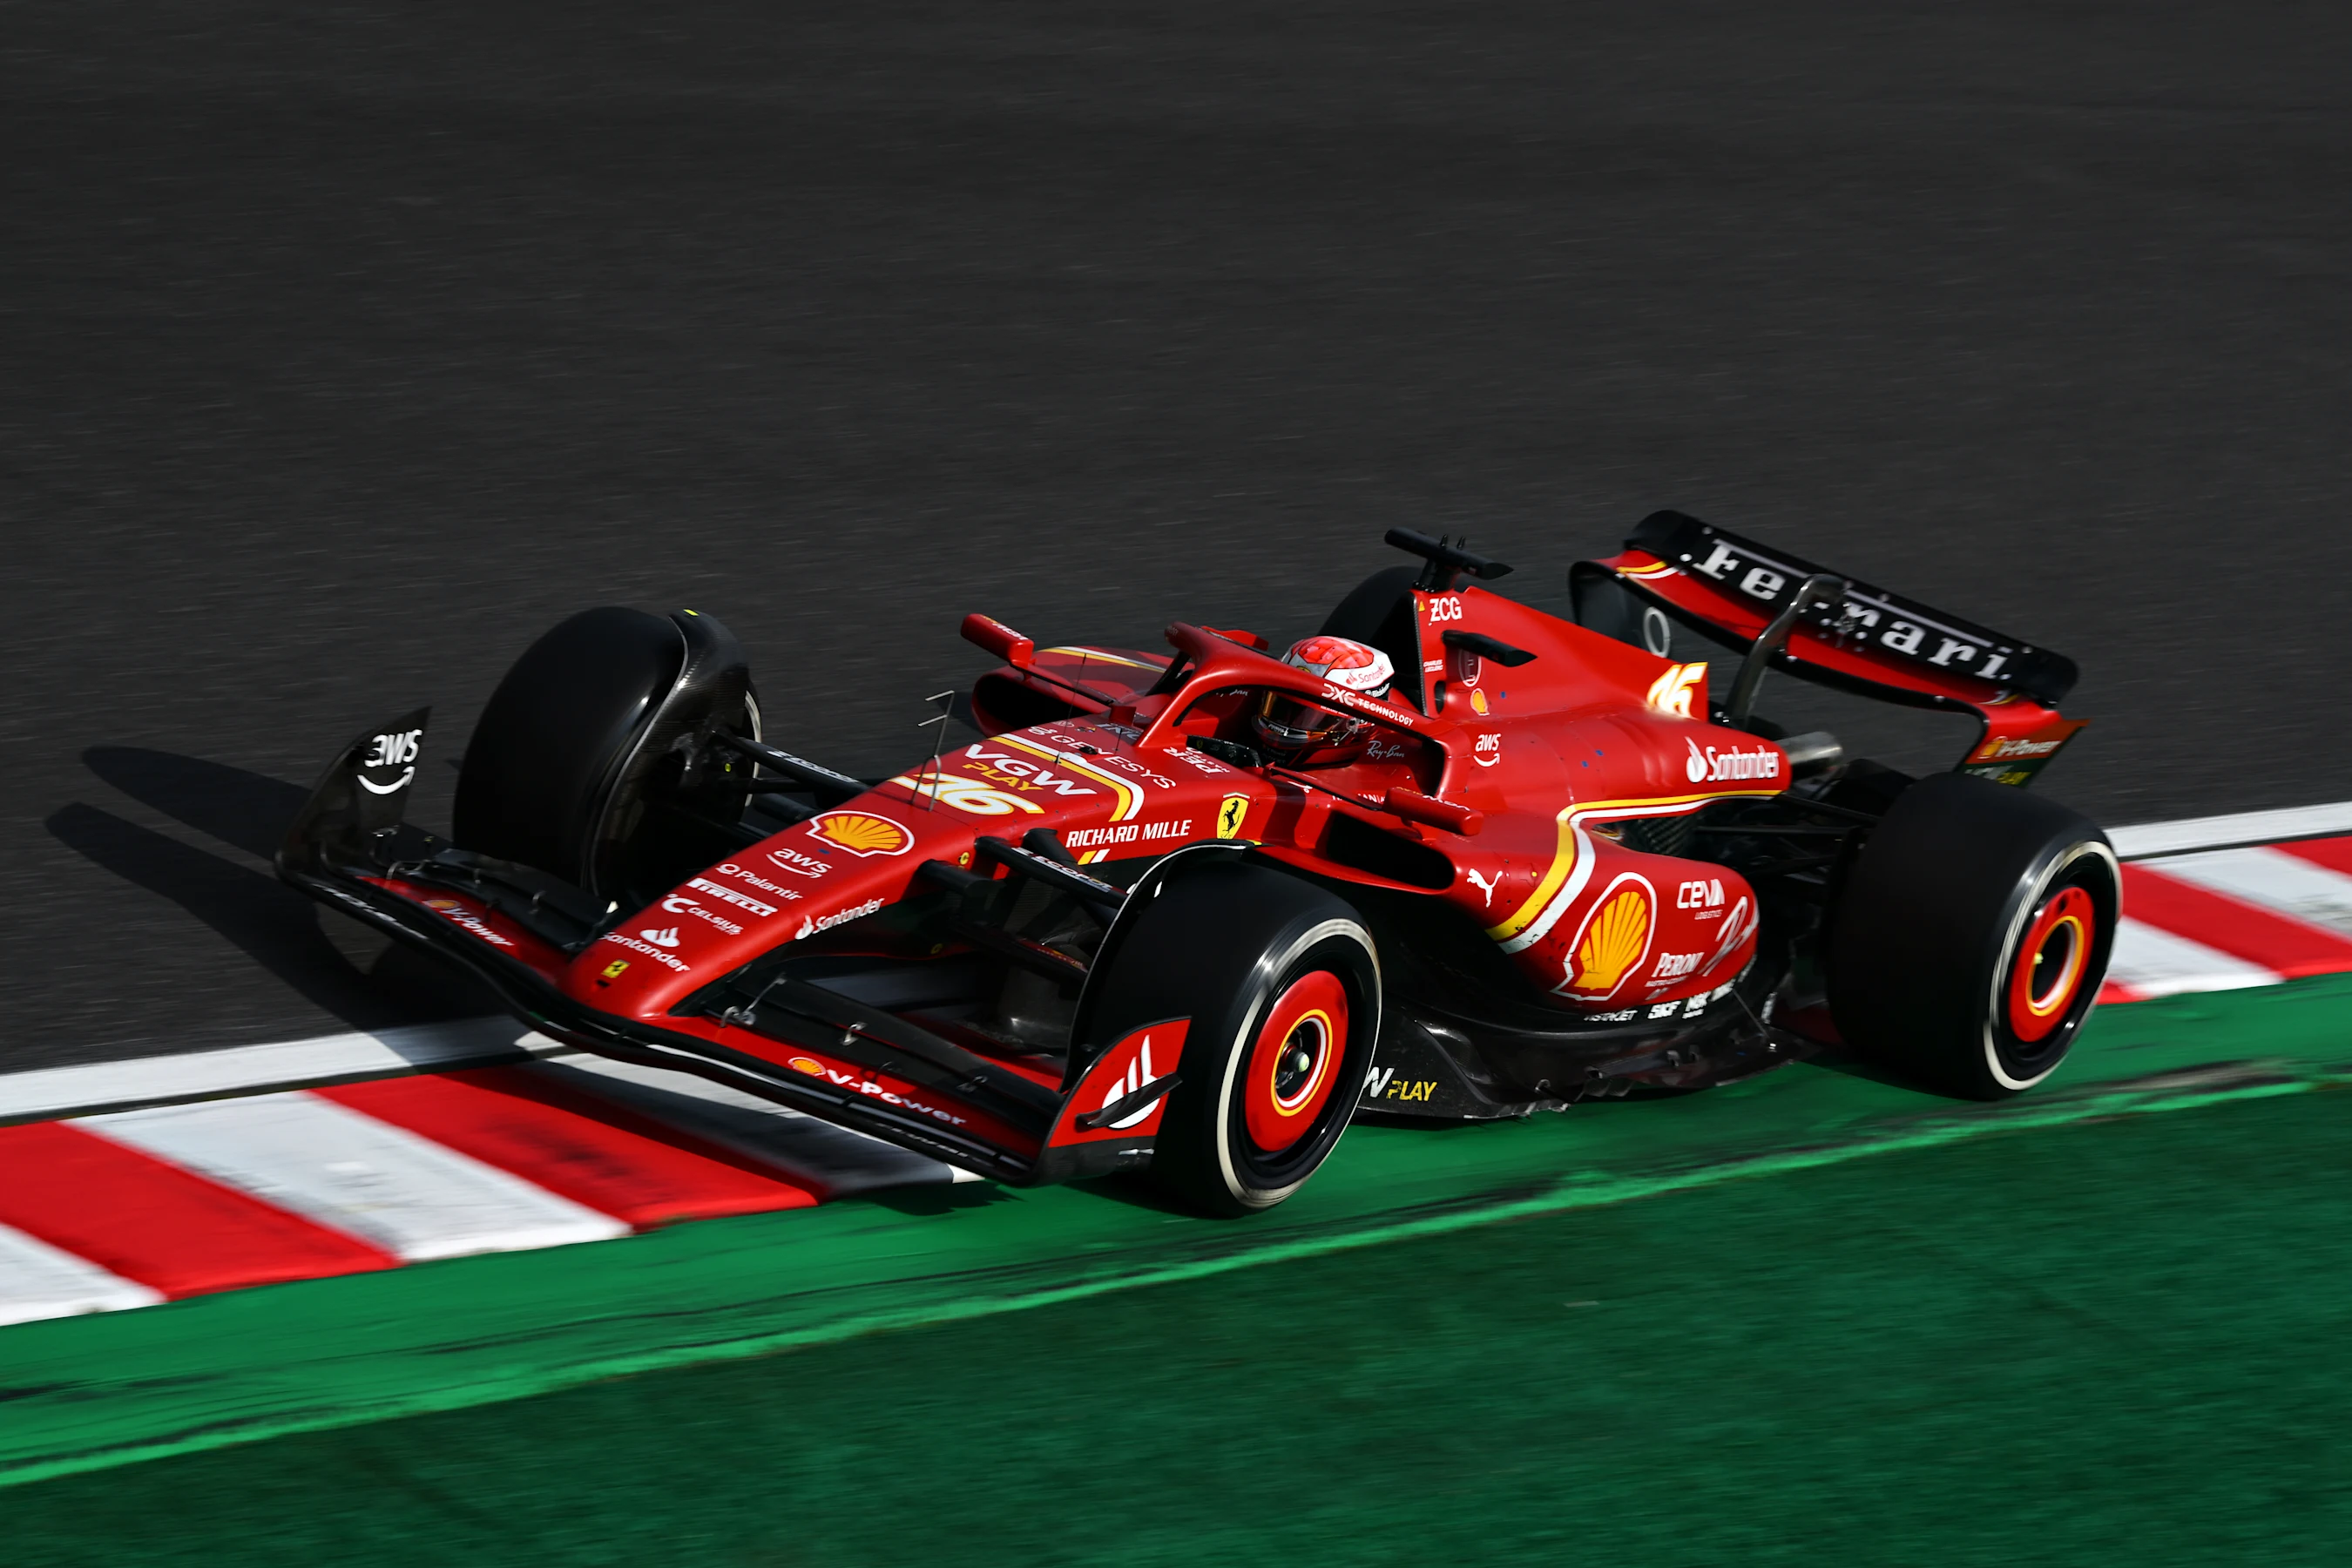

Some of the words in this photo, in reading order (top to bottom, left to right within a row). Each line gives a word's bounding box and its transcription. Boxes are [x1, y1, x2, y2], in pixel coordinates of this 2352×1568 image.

[1429, 597, 1463, 622] ZCG
[1692, 538, 2013, 679] Ferari
[1646, 662, 1708, 720] 16
[1358, 698, 1414, 727] TECHNOLOGY
[1367, 740, 1405, 760] Ray-Ban
[1475, 733, 1501, 752] aws
[962, 762, 1044, 791] PLAY
[965, 744, 1098, 795] VGW
[1706, 745, 1779, 781] Santander
[888, 773, 1044, 815] 16
[1066, 825, 1139, 848] RICHARD
[1142, 820, 1193, 841] MILLE
[774, 848, 833, 874] aws
[686, 877, 778, 917] PIRELLI
[733, 870, 803, 900] Palantir
[687, 907, 744, 934] CELSIUS
[812, 897, 885, 934] Santander
[598, 931, 690, 972] Santander
[827, 1069, 966, 1125] V-Power
[1386, 1080, 1438, 1101] PLAY
